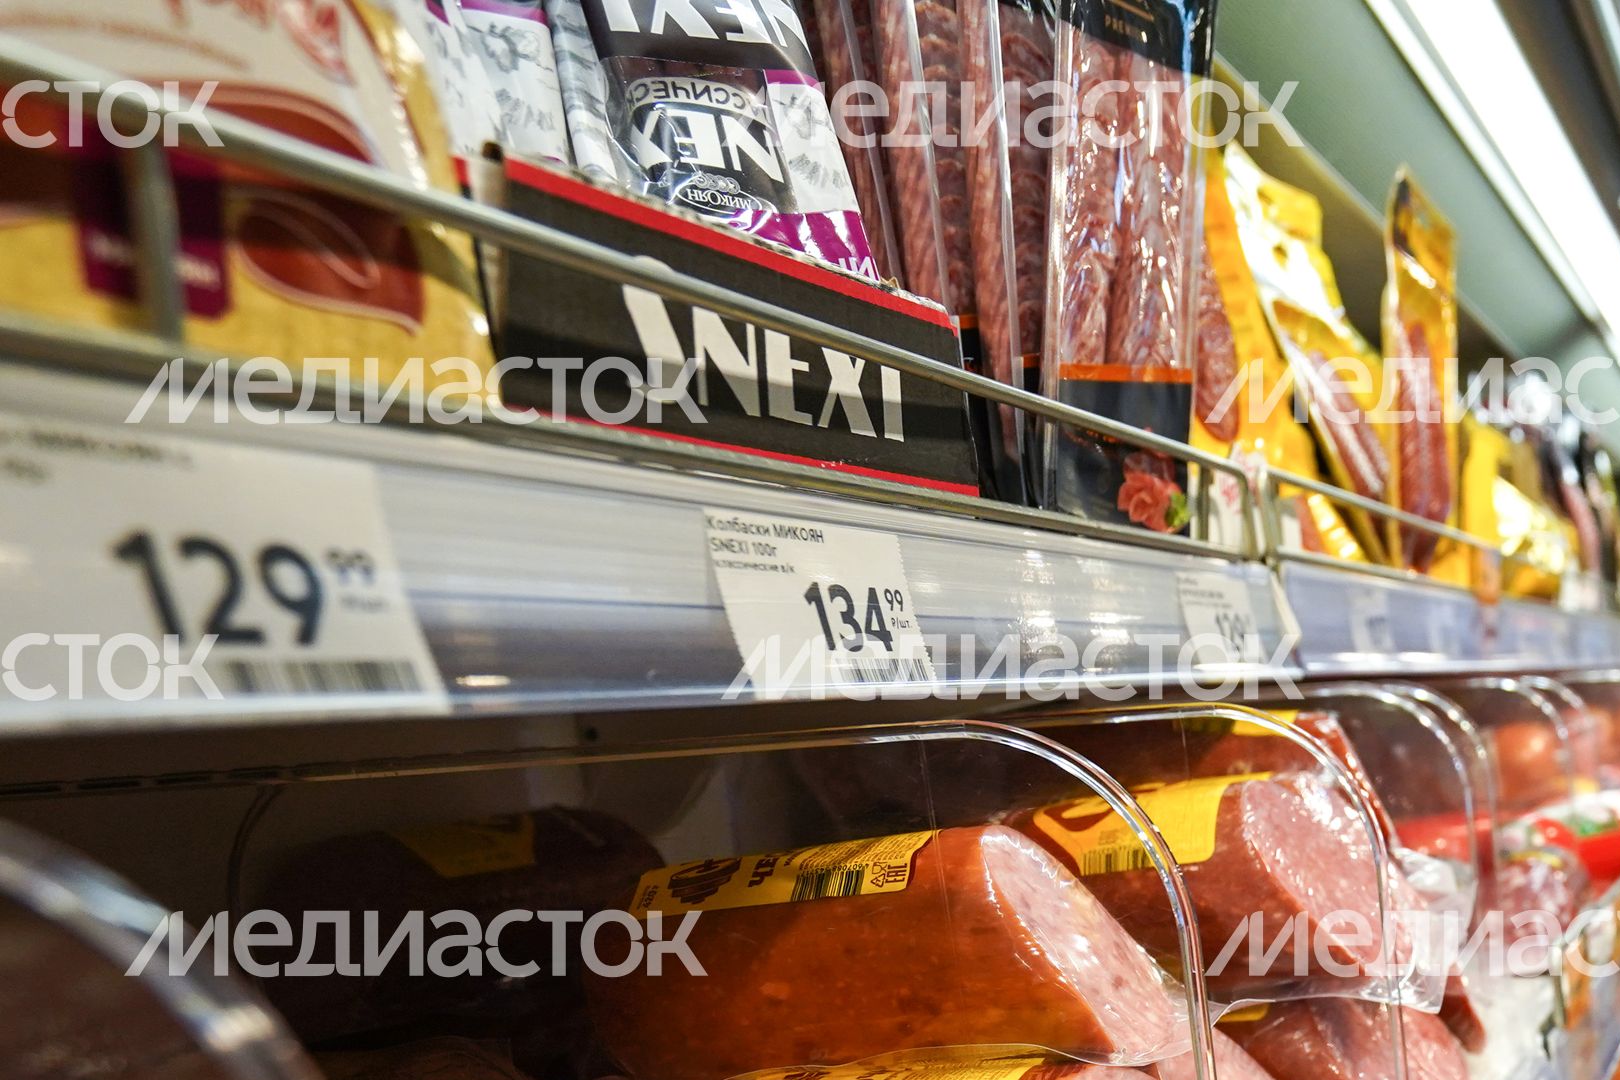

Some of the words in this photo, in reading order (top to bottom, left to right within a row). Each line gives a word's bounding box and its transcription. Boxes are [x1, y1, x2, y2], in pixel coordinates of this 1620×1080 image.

[773, 524, 826, 544] МИКОЯН
[112, 531, 324, 647] 129
[804, 581, 894, 653] 134
[883, 588, 904, 613] 99
